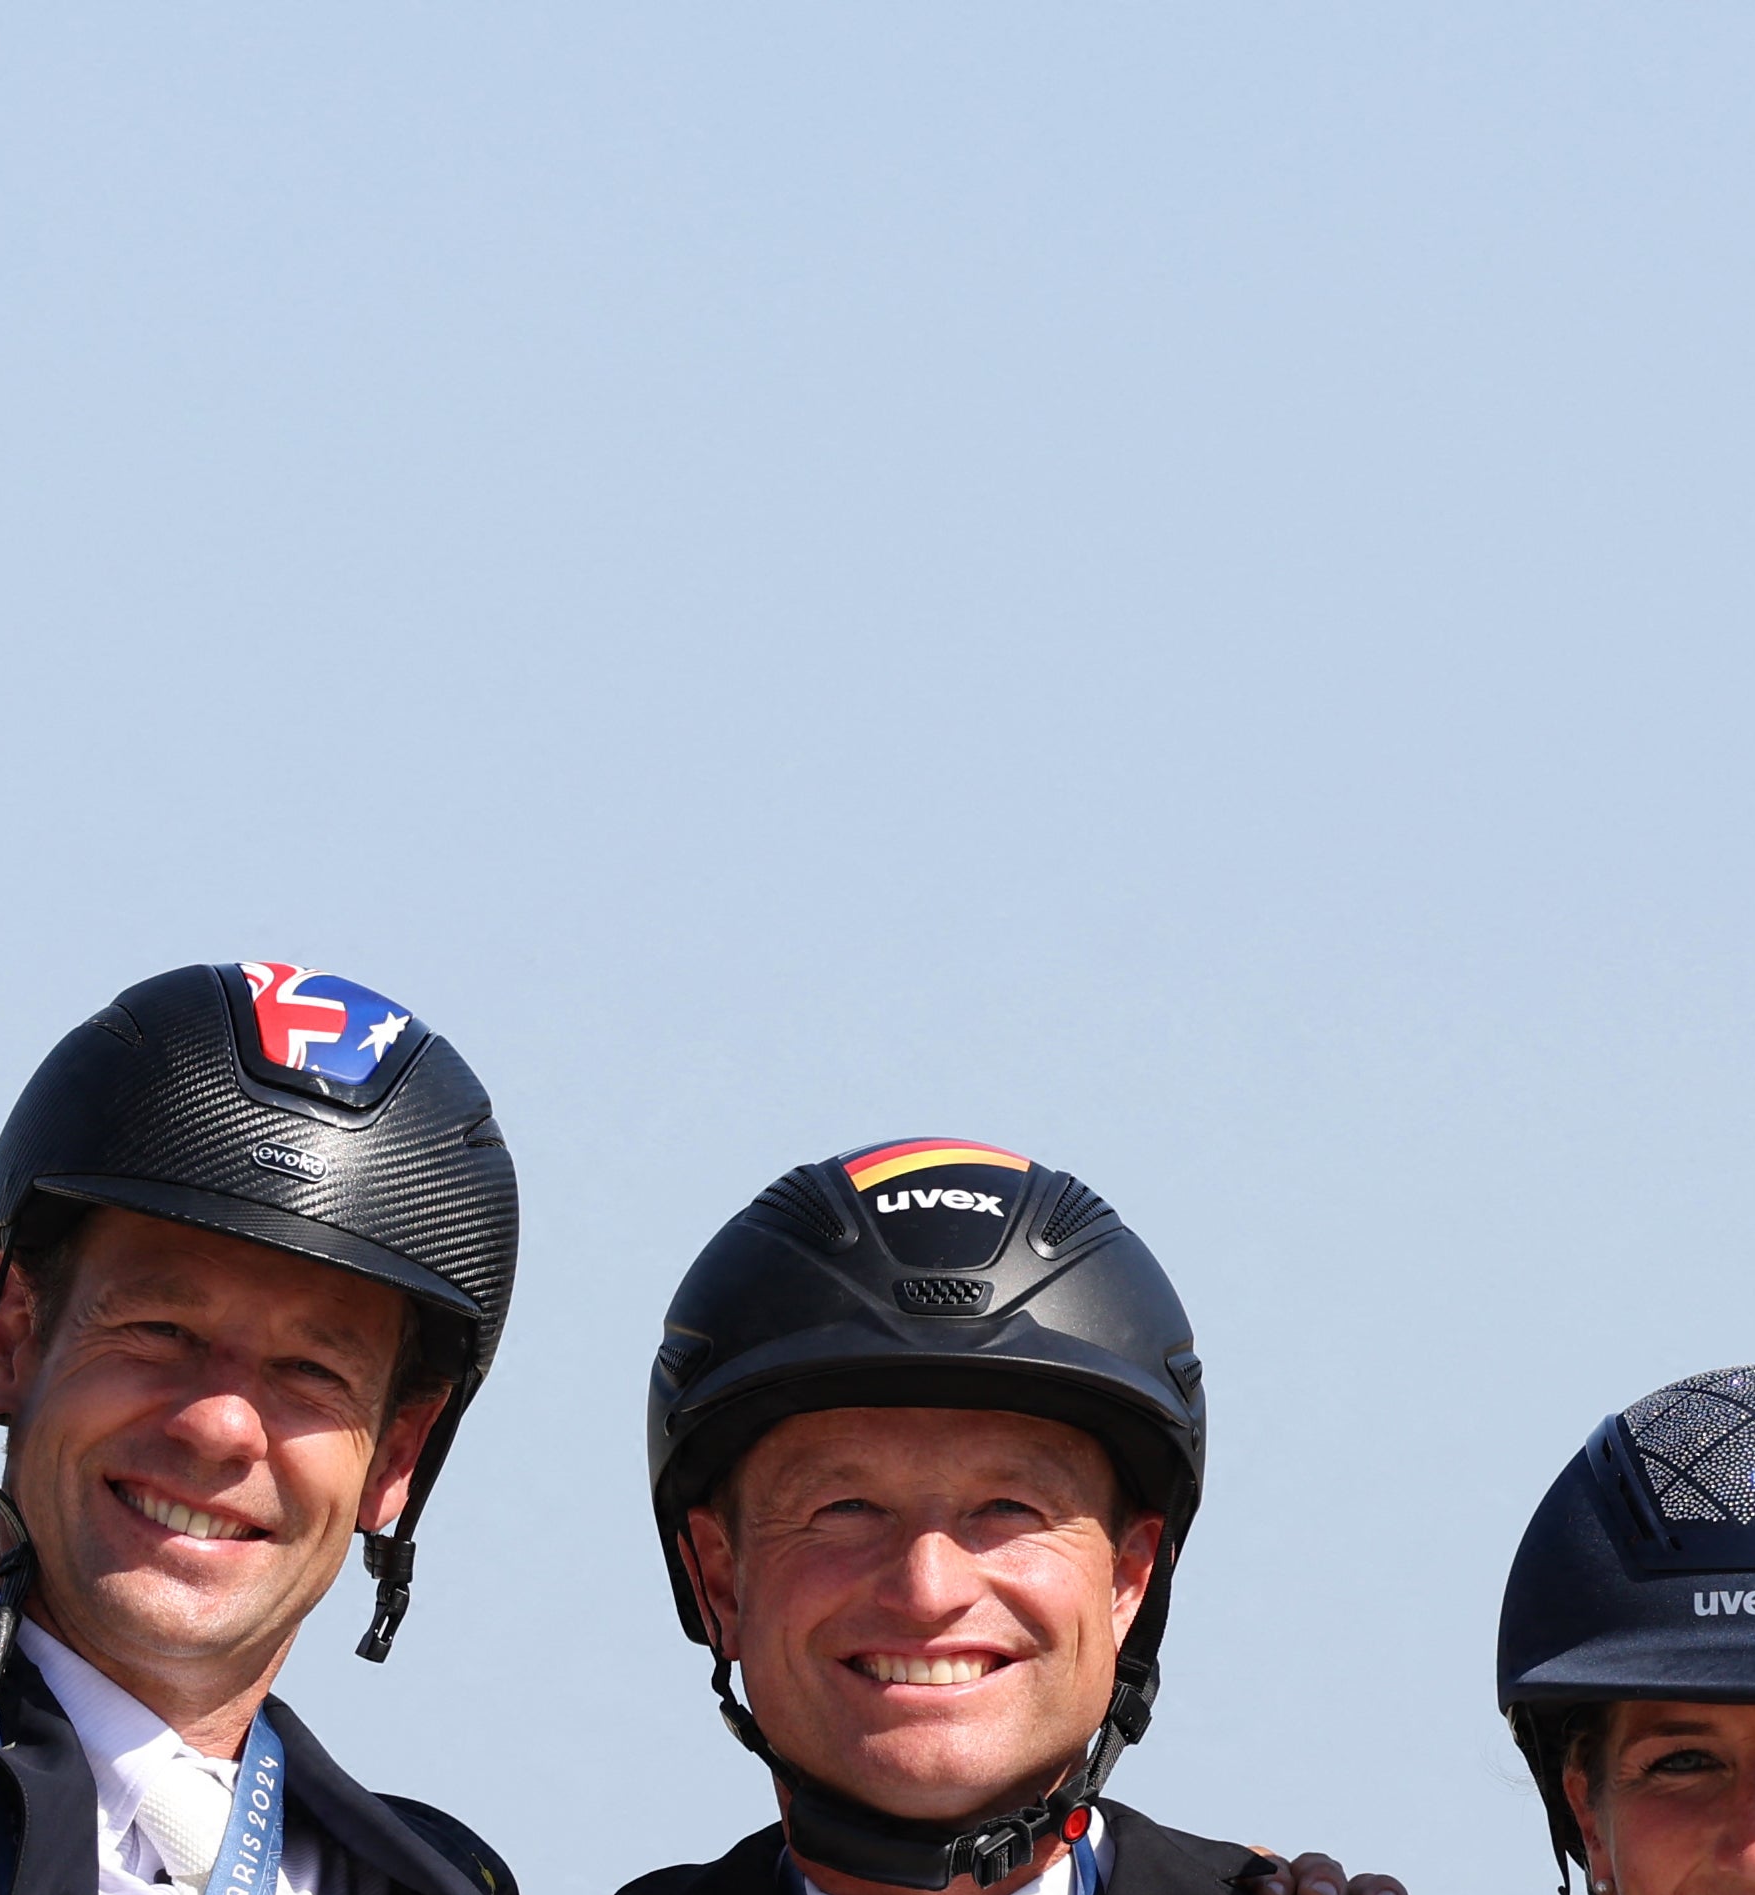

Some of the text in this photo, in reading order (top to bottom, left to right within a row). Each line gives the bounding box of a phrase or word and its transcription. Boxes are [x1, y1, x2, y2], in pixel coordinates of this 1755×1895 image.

[258, 1146, 324, 1176] evoke
[876, 1188, 1005, 1218] uvex
[247, 1754, 279, 1832] 2024
